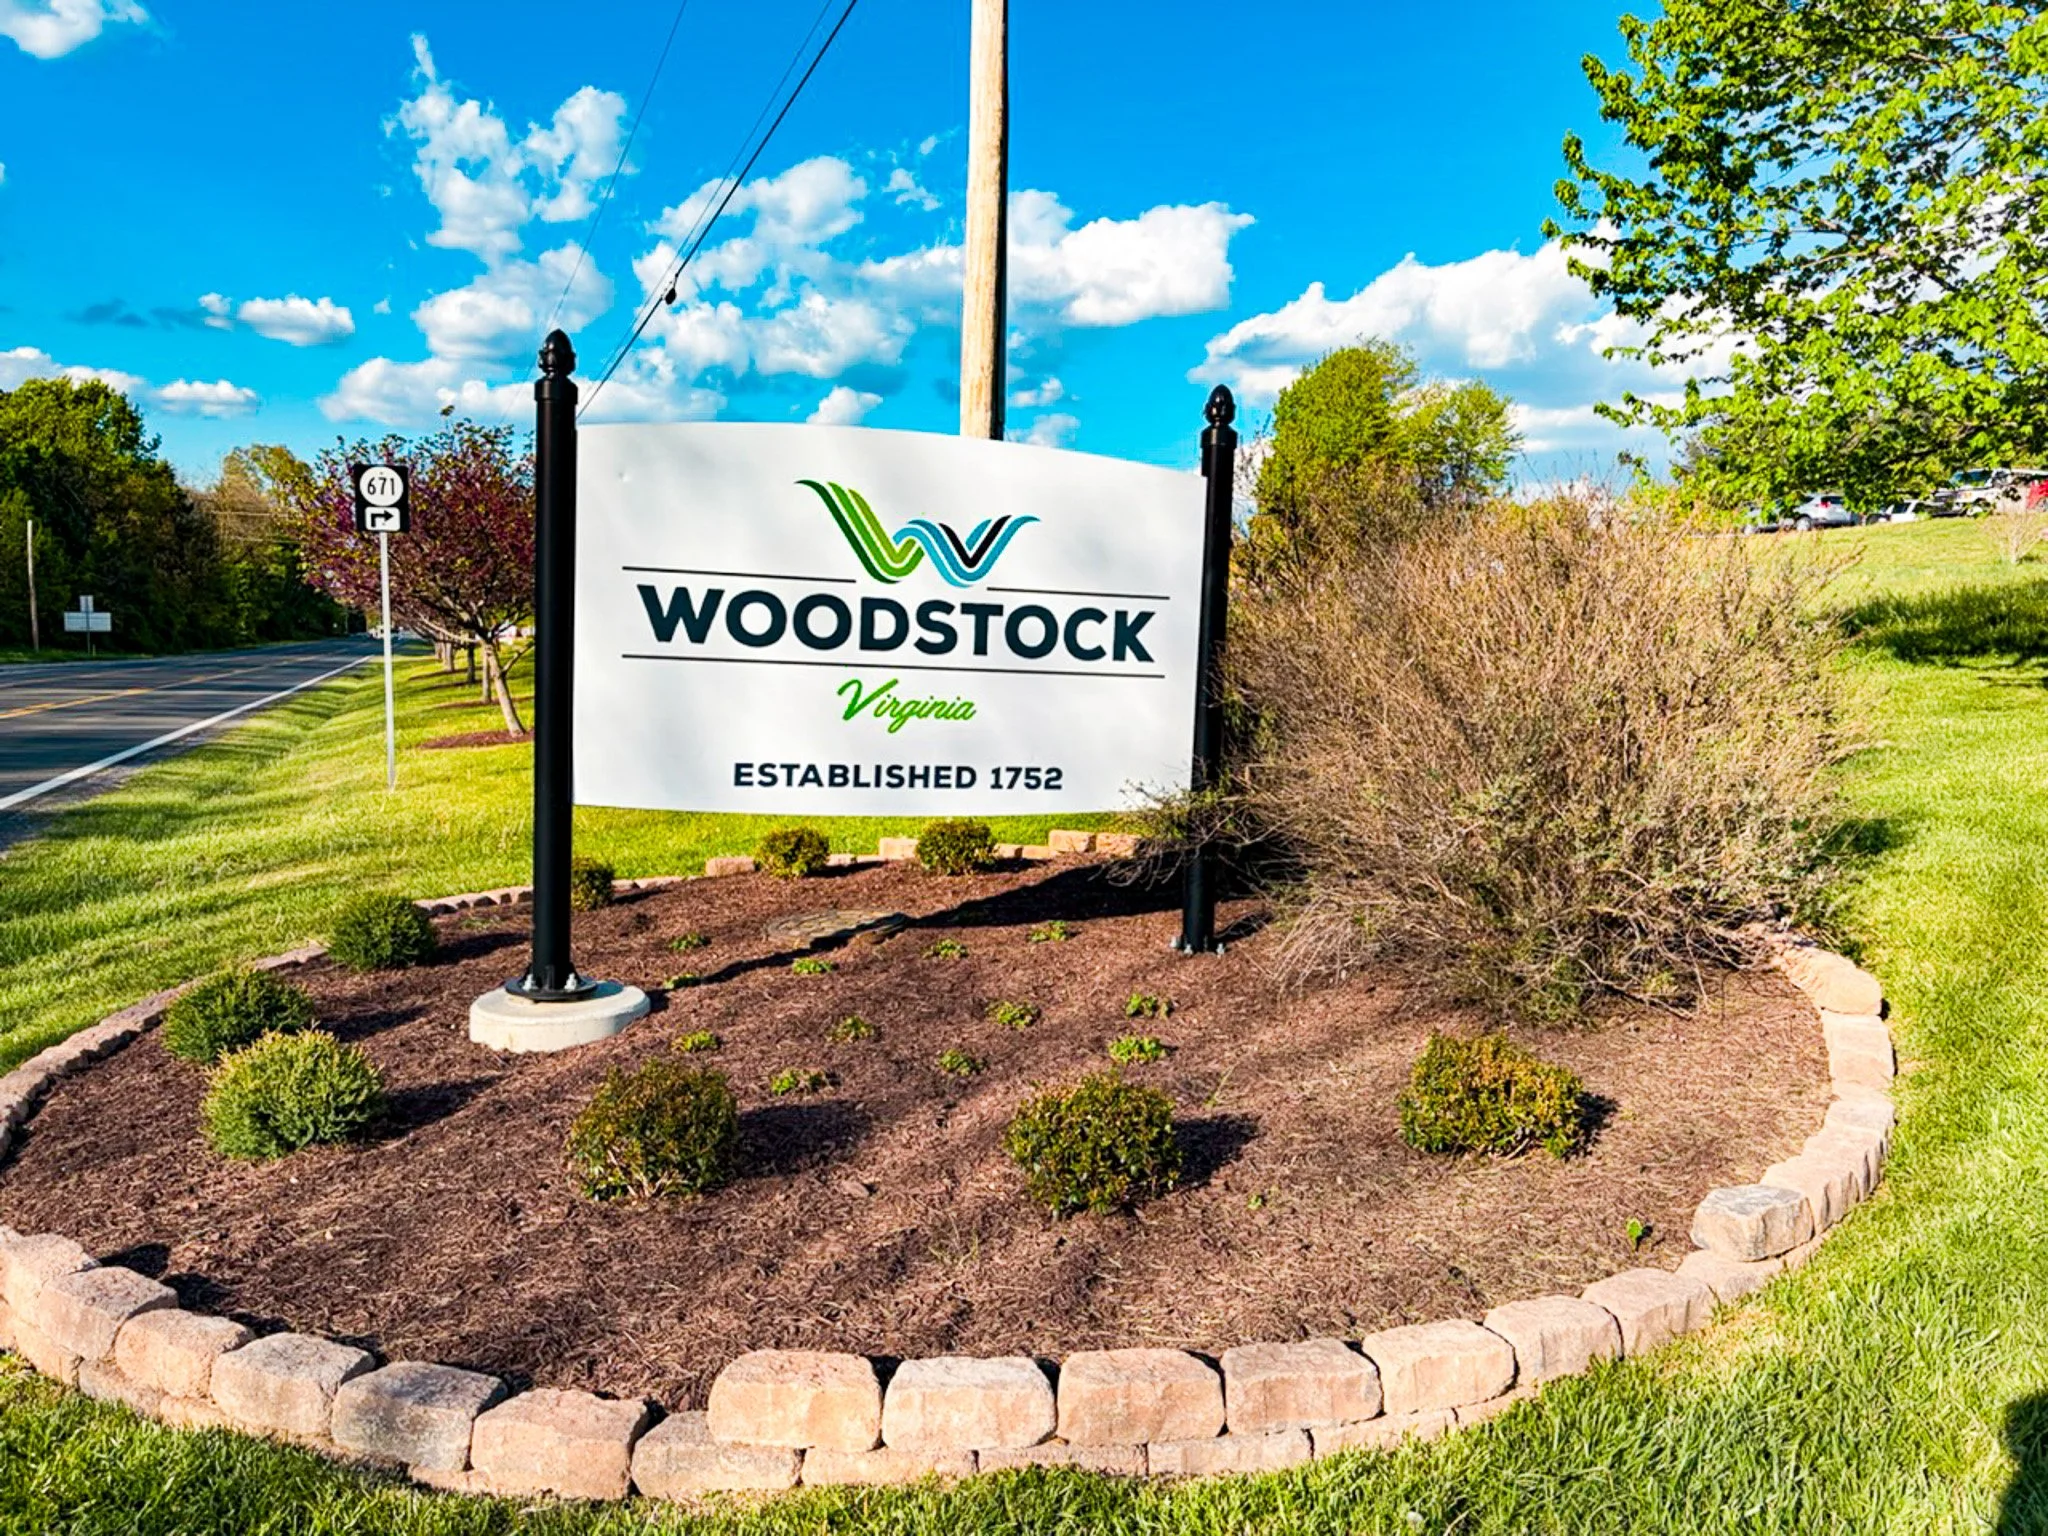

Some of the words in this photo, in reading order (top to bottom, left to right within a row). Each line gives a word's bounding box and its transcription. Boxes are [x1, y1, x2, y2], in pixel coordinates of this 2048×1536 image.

[367, 476, 395, 496] 671
[636, 583, 1156, 663] WOODSTOCK
[836, 678, 976, 734] Virginia
[733, 762, 977, 790] ESTABLISHED
[990, 766, 1063, 791] 1752
